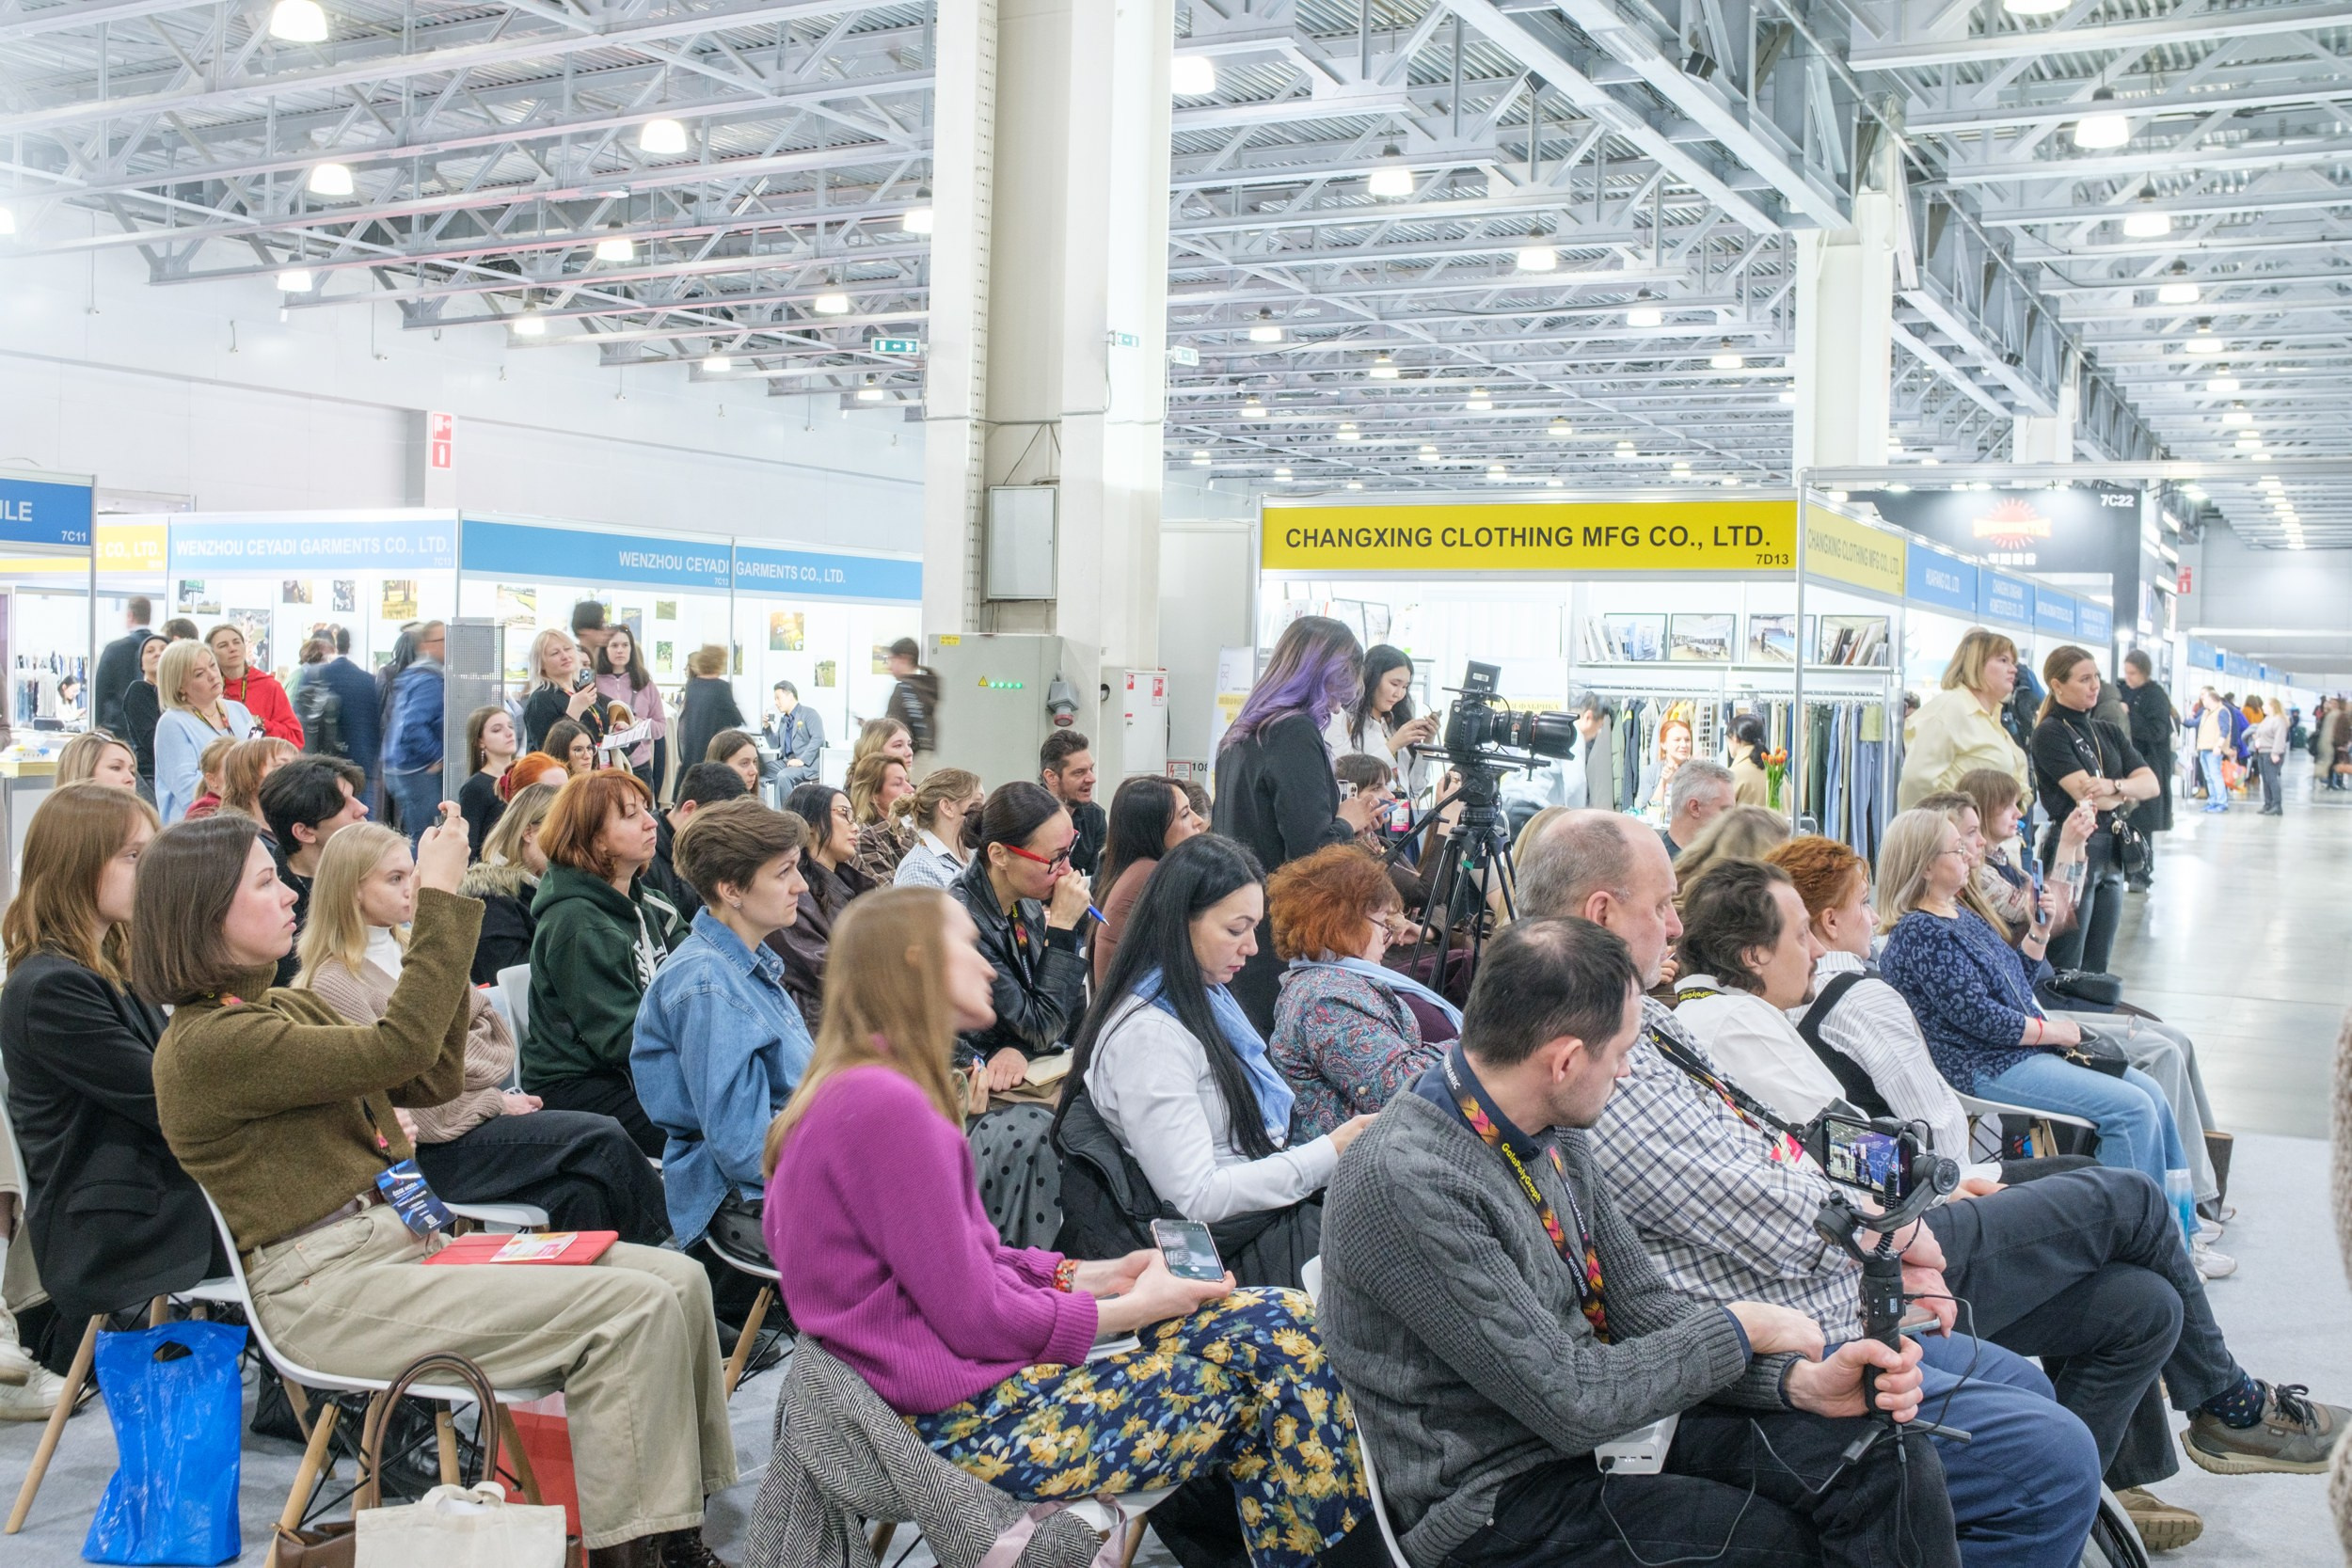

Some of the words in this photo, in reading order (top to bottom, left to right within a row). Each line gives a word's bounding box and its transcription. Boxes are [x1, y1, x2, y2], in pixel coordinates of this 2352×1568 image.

[2100, 494, 2135, 507] 7C22
[61, 531, 87, 543] 7C11
[176, 539, 244, 556] WENZHOU
[246, 539, 297, 556] CEYADI
[300, 537, 381, 554] GARMENTS
[385, 536, 414, 555] CO.,
[419, 536, 451, 553] LTD.
[1285, 527, 1434, 548] CHANGXING
[1440, 526, 1574, 548] CLOTHING
[1582, 526, 1641, 547] MFG
[1649, 525, 1703, 551] CO.,
[1713, 525, 1772, 546] LTD.
[134, 541, 162, 558] LTD.
[1756, 553, 1789, 565] 7D13
[1807, 530, 1841, 559] CHANGXING
[1842, 541, 1868, 566] CLOTHING
[1868, 548, 1880, 570] MFG
[618, 551, 683, 571] WENZHOU
[686, 557, 729, 575] CEYADI
[736, 561, 798, 580] GARMENTS
[801, 566, 822, 584] CO.,
[824, 568, 847, 583] LTD.
[714, 577, 729, 586] 7C13
[1501, 1143, 1542, 1203] GalaPolyGraph
[1566, 1255, 1588, 1298] ИНТЕРТКАНЬ
